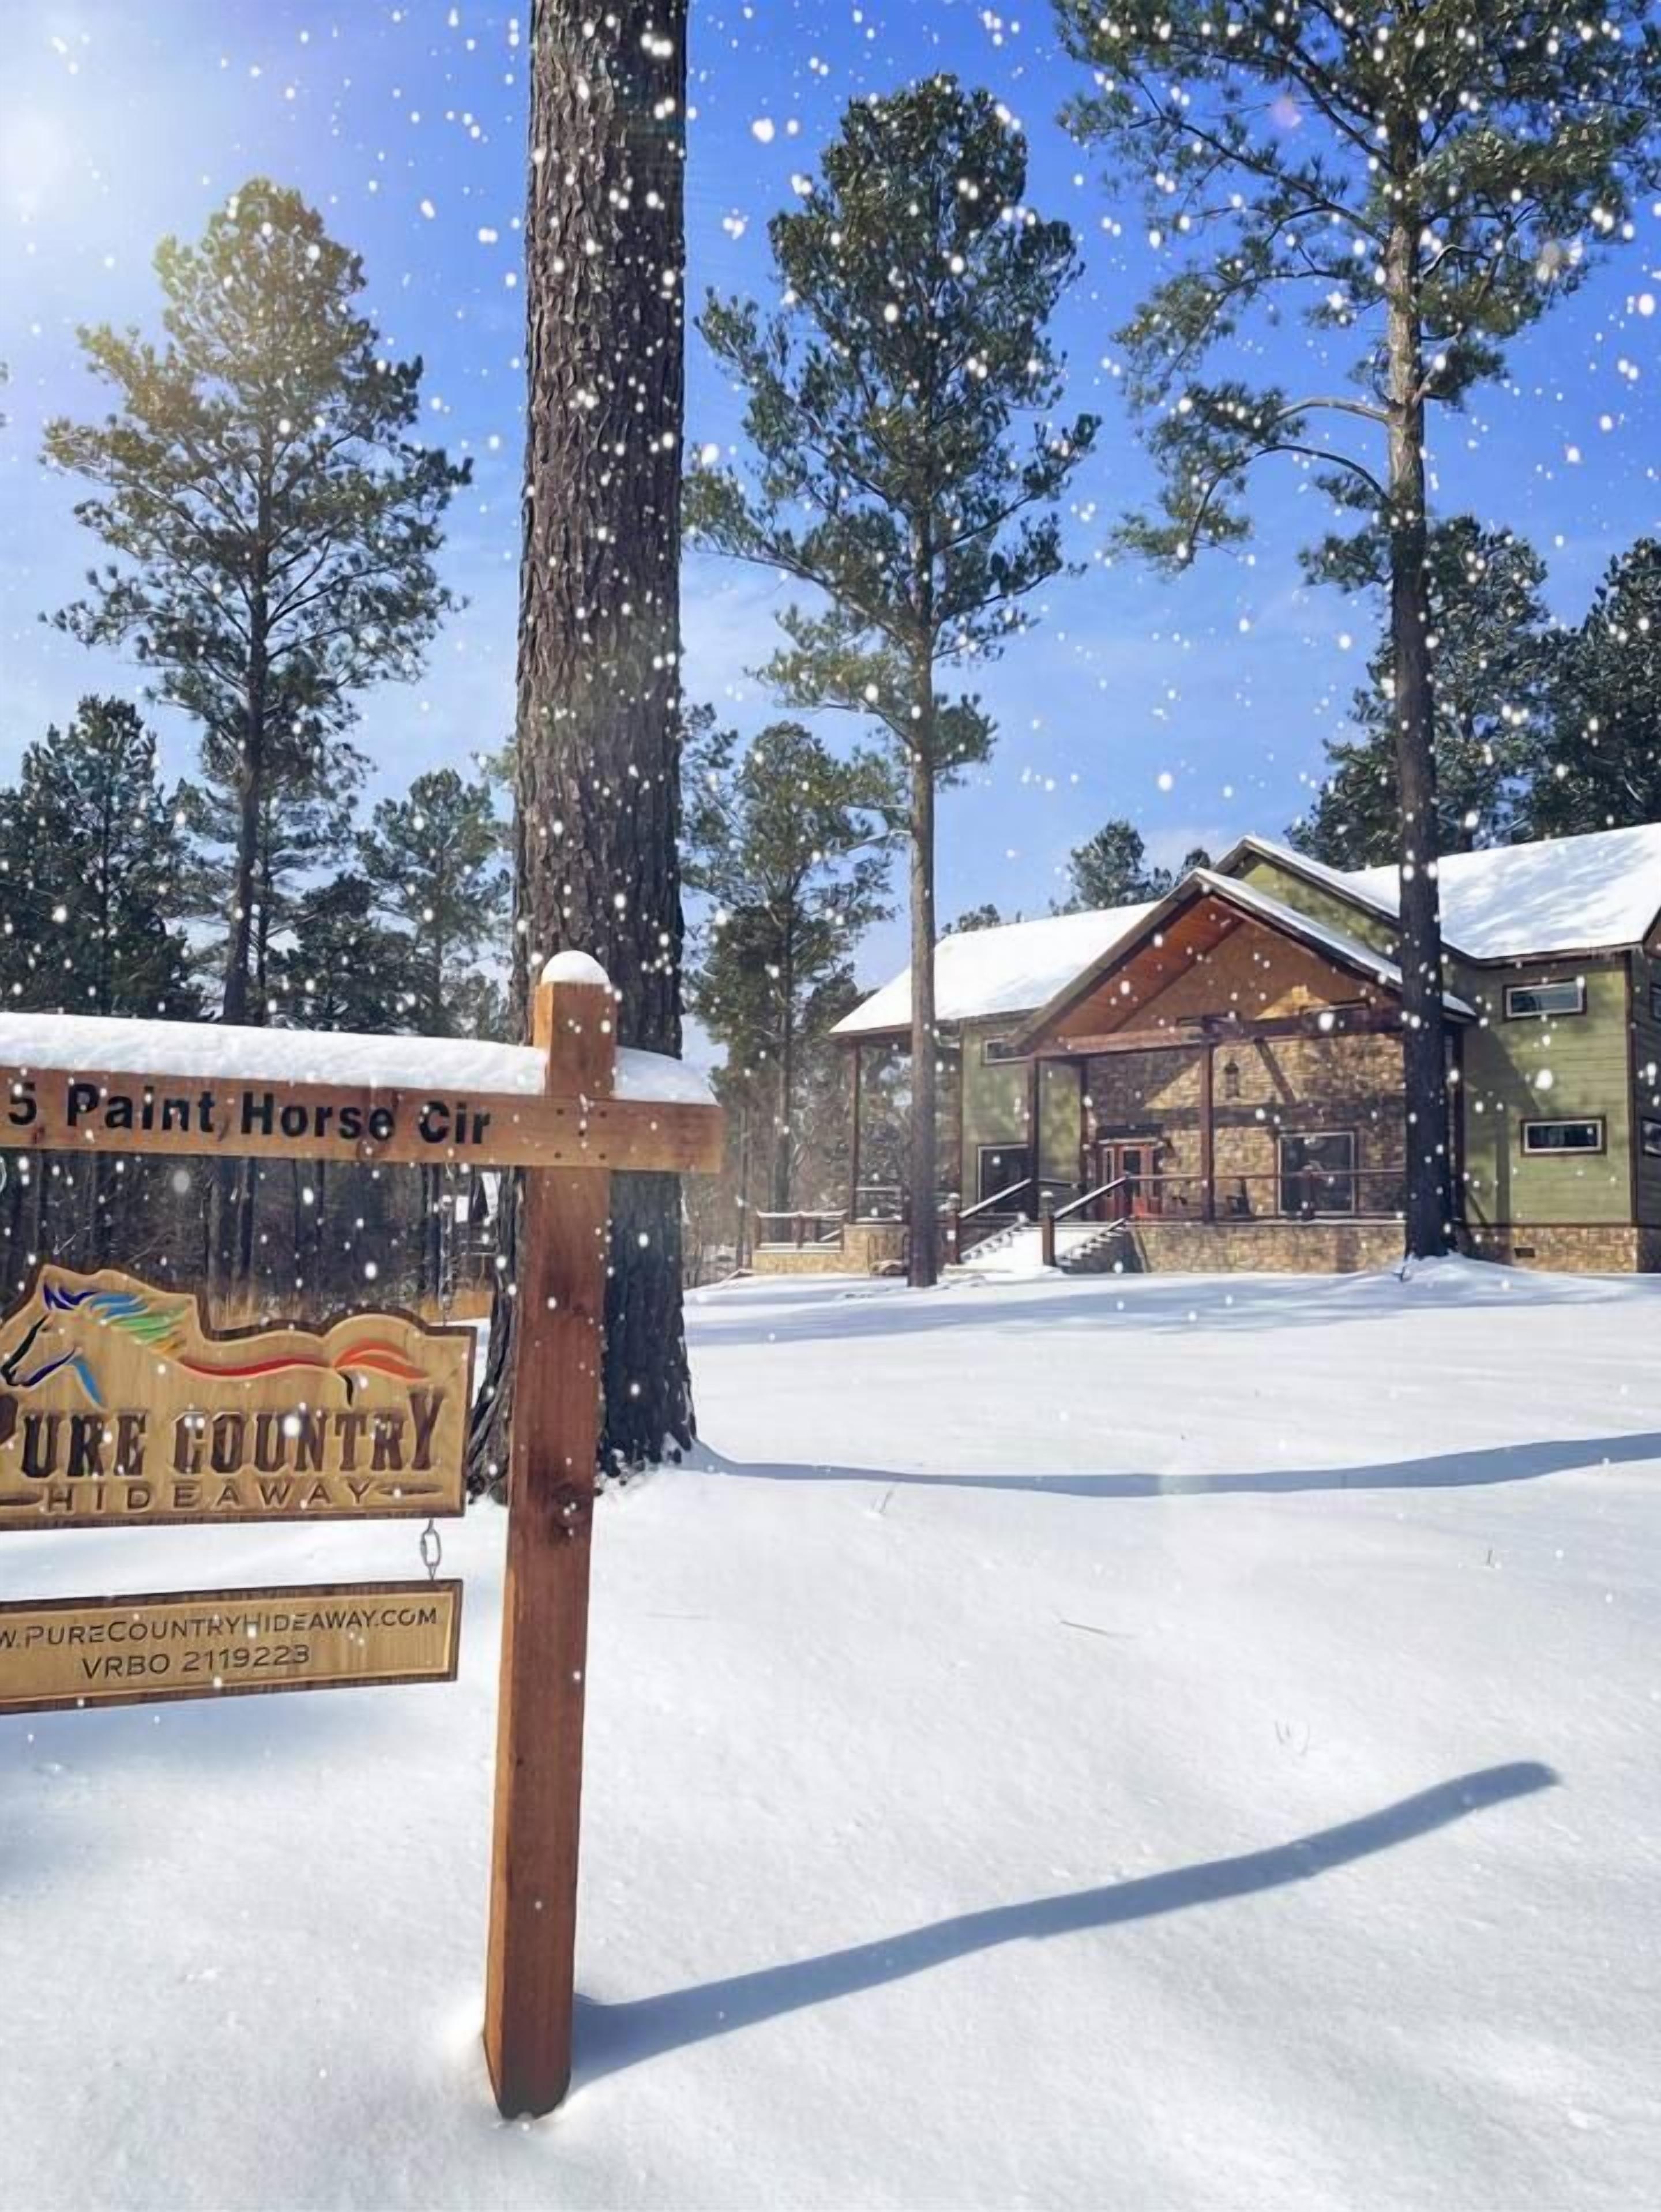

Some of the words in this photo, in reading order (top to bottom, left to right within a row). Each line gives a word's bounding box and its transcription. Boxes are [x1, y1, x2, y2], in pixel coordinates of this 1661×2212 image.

[9, 1082, 37, 1126] 5
[67, 1083, 215, 1133] Paint
[240, 1092, 395, 1139] Horse
[418, 1100, 491, 1144] Cir
[173, 1386, 444, 1475] COUNTRY
[46, 1481, 373, 1511] HIDEAWAY
[82, 1653, 171, 1679] VRBO
[182, 1645, 310, 1672] 2119223
